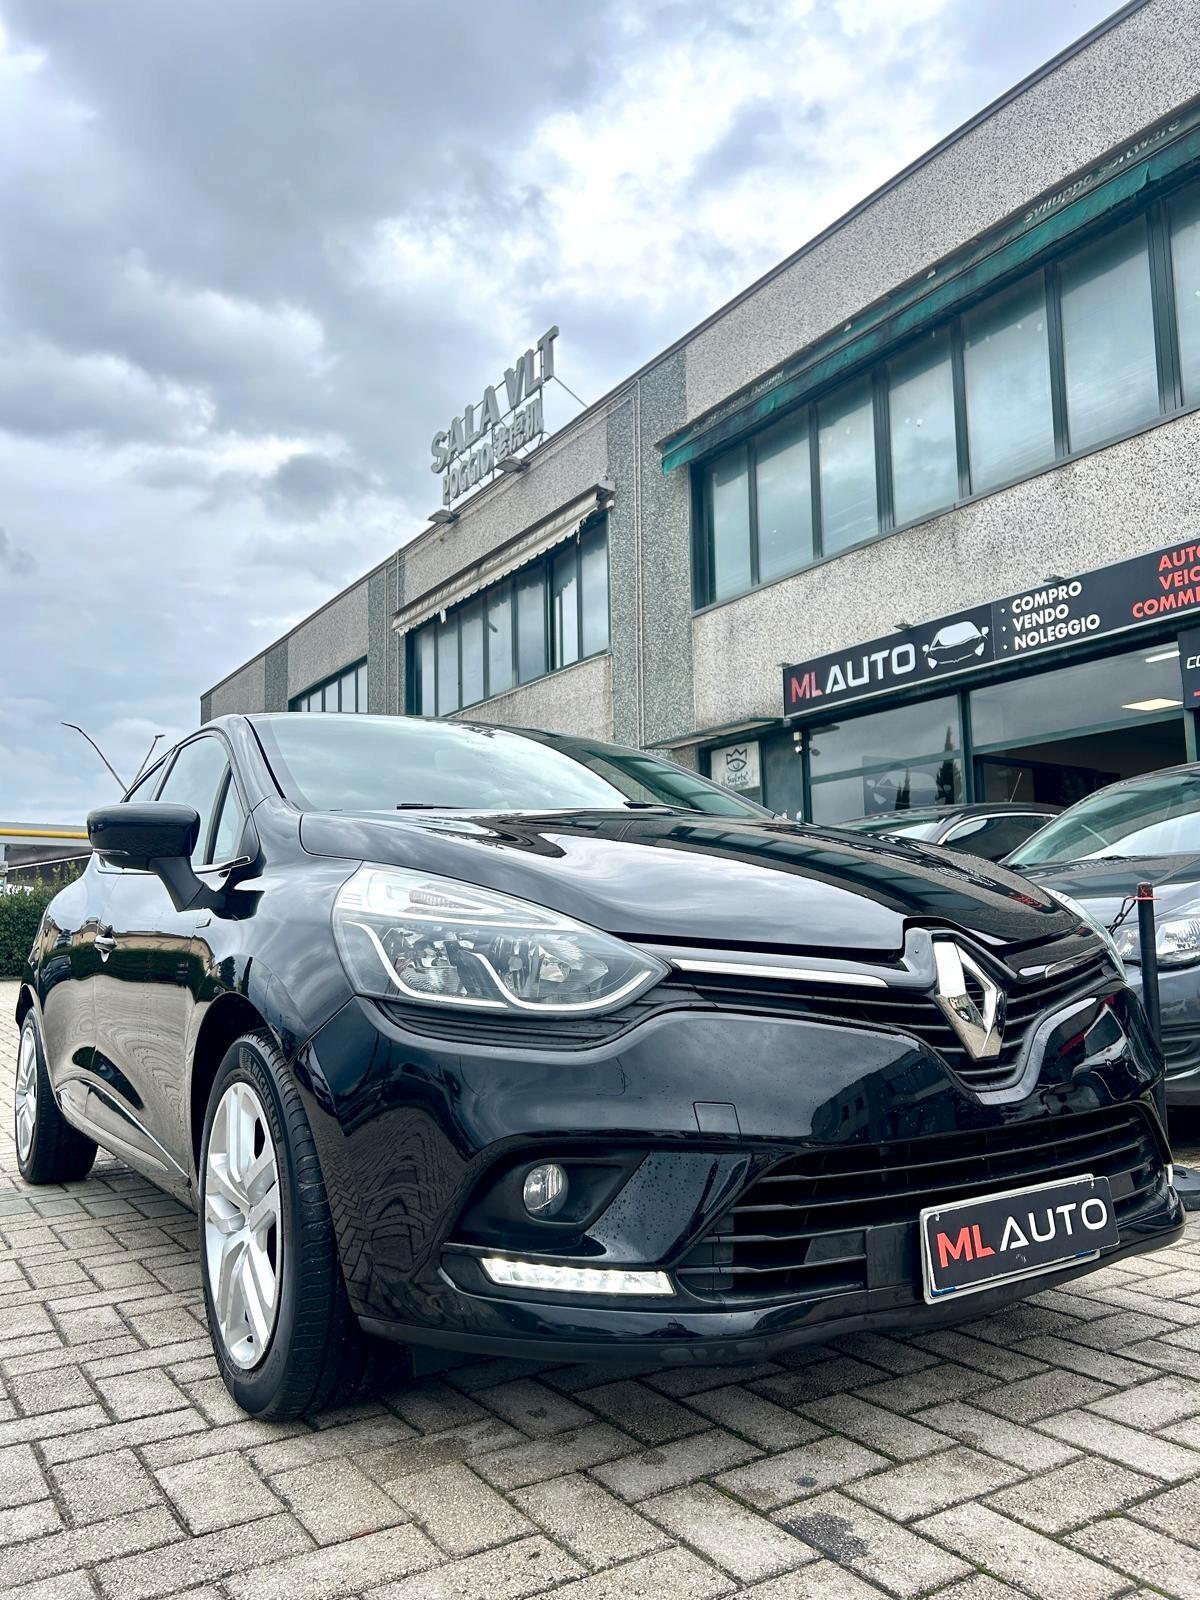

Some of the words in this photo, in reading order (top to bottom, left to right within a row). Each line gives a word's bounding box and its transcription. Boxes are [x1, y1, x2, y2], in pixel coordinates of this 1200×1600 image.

[430, 385, 500, 474] SALA
[504, 325, 559, 410] VLT
[1011, 581, 1082, 613] COMPRO
[1012, 604, 1069, 631] VENDO
[1014, 614, 1101, 650] NOLEGGIO
[249, 1060, 281, 1141] MICHELIN
